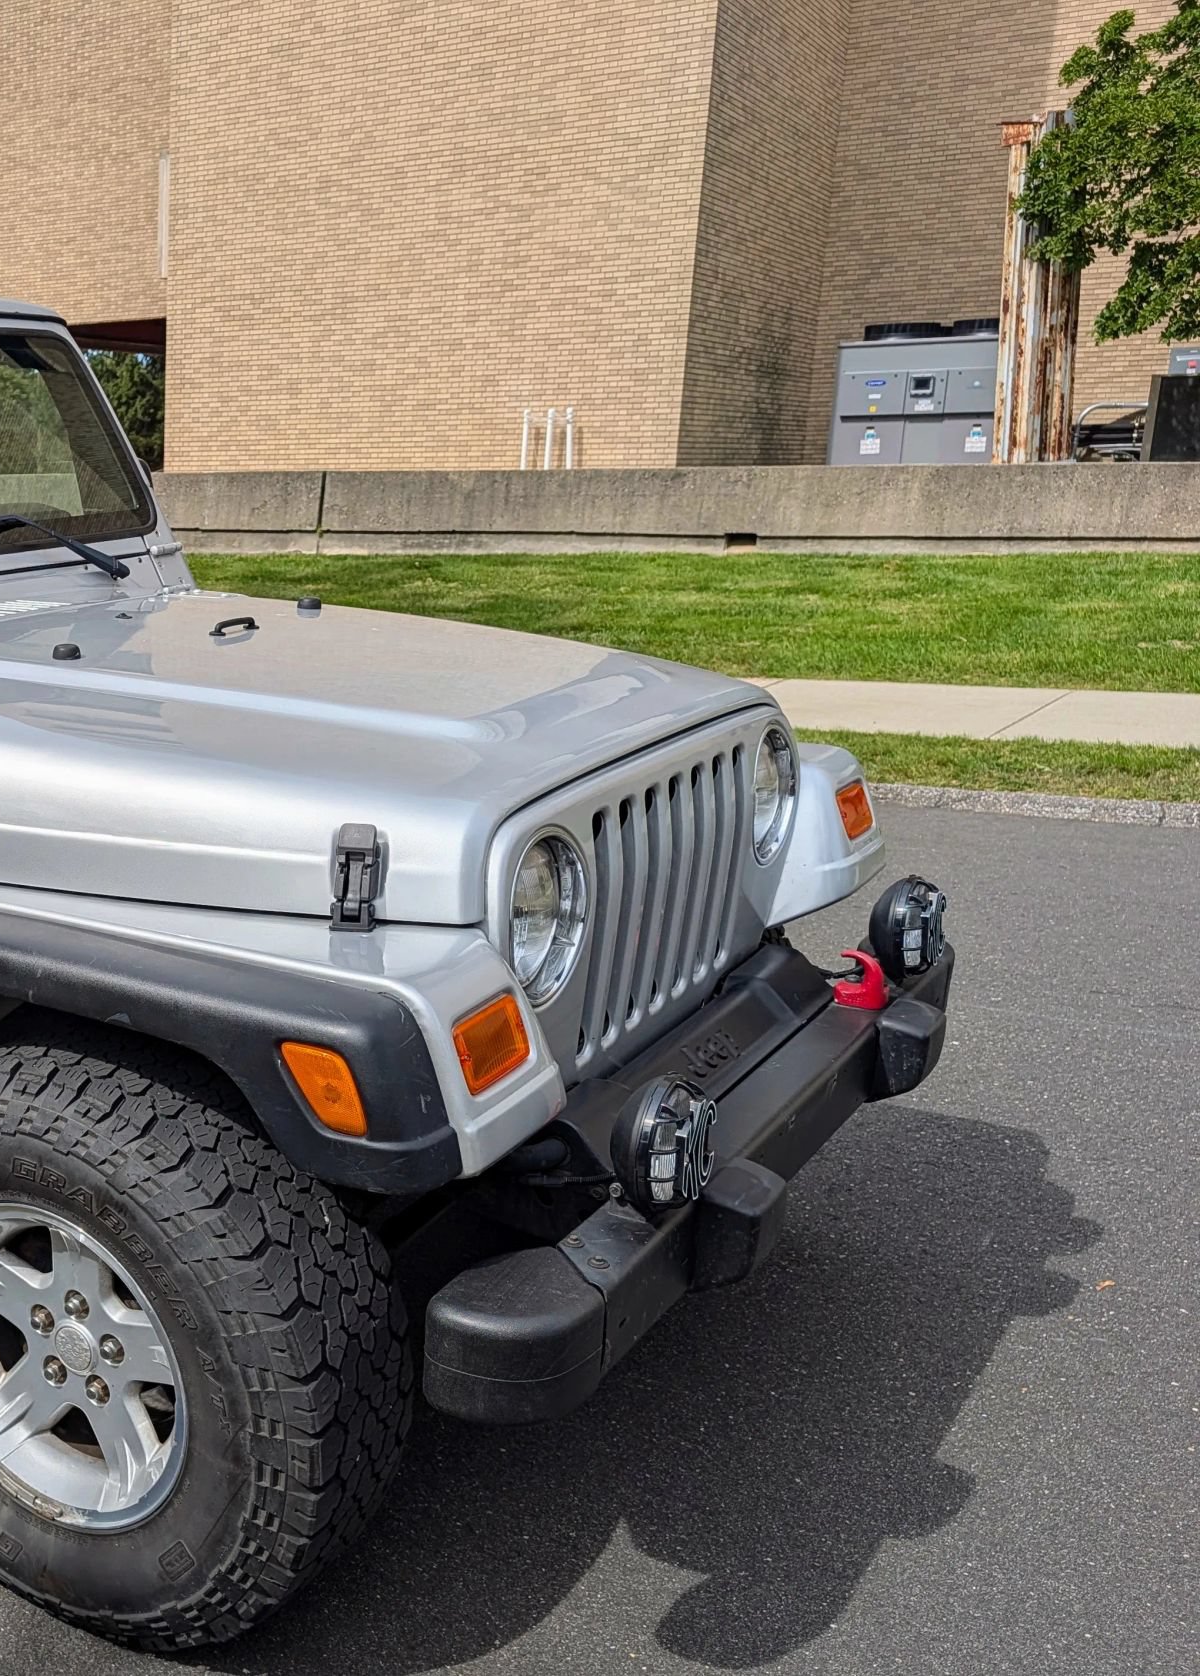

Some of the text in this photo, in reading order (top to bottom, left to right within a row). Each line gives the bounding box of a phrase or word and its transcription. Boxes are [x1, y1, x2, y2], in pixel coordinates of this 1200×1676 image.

[679, 1028, 742, 1078] Jeep
[675, 1098, 718, 1200] KC
[11, 1156, 199, 1331] GRABBER
